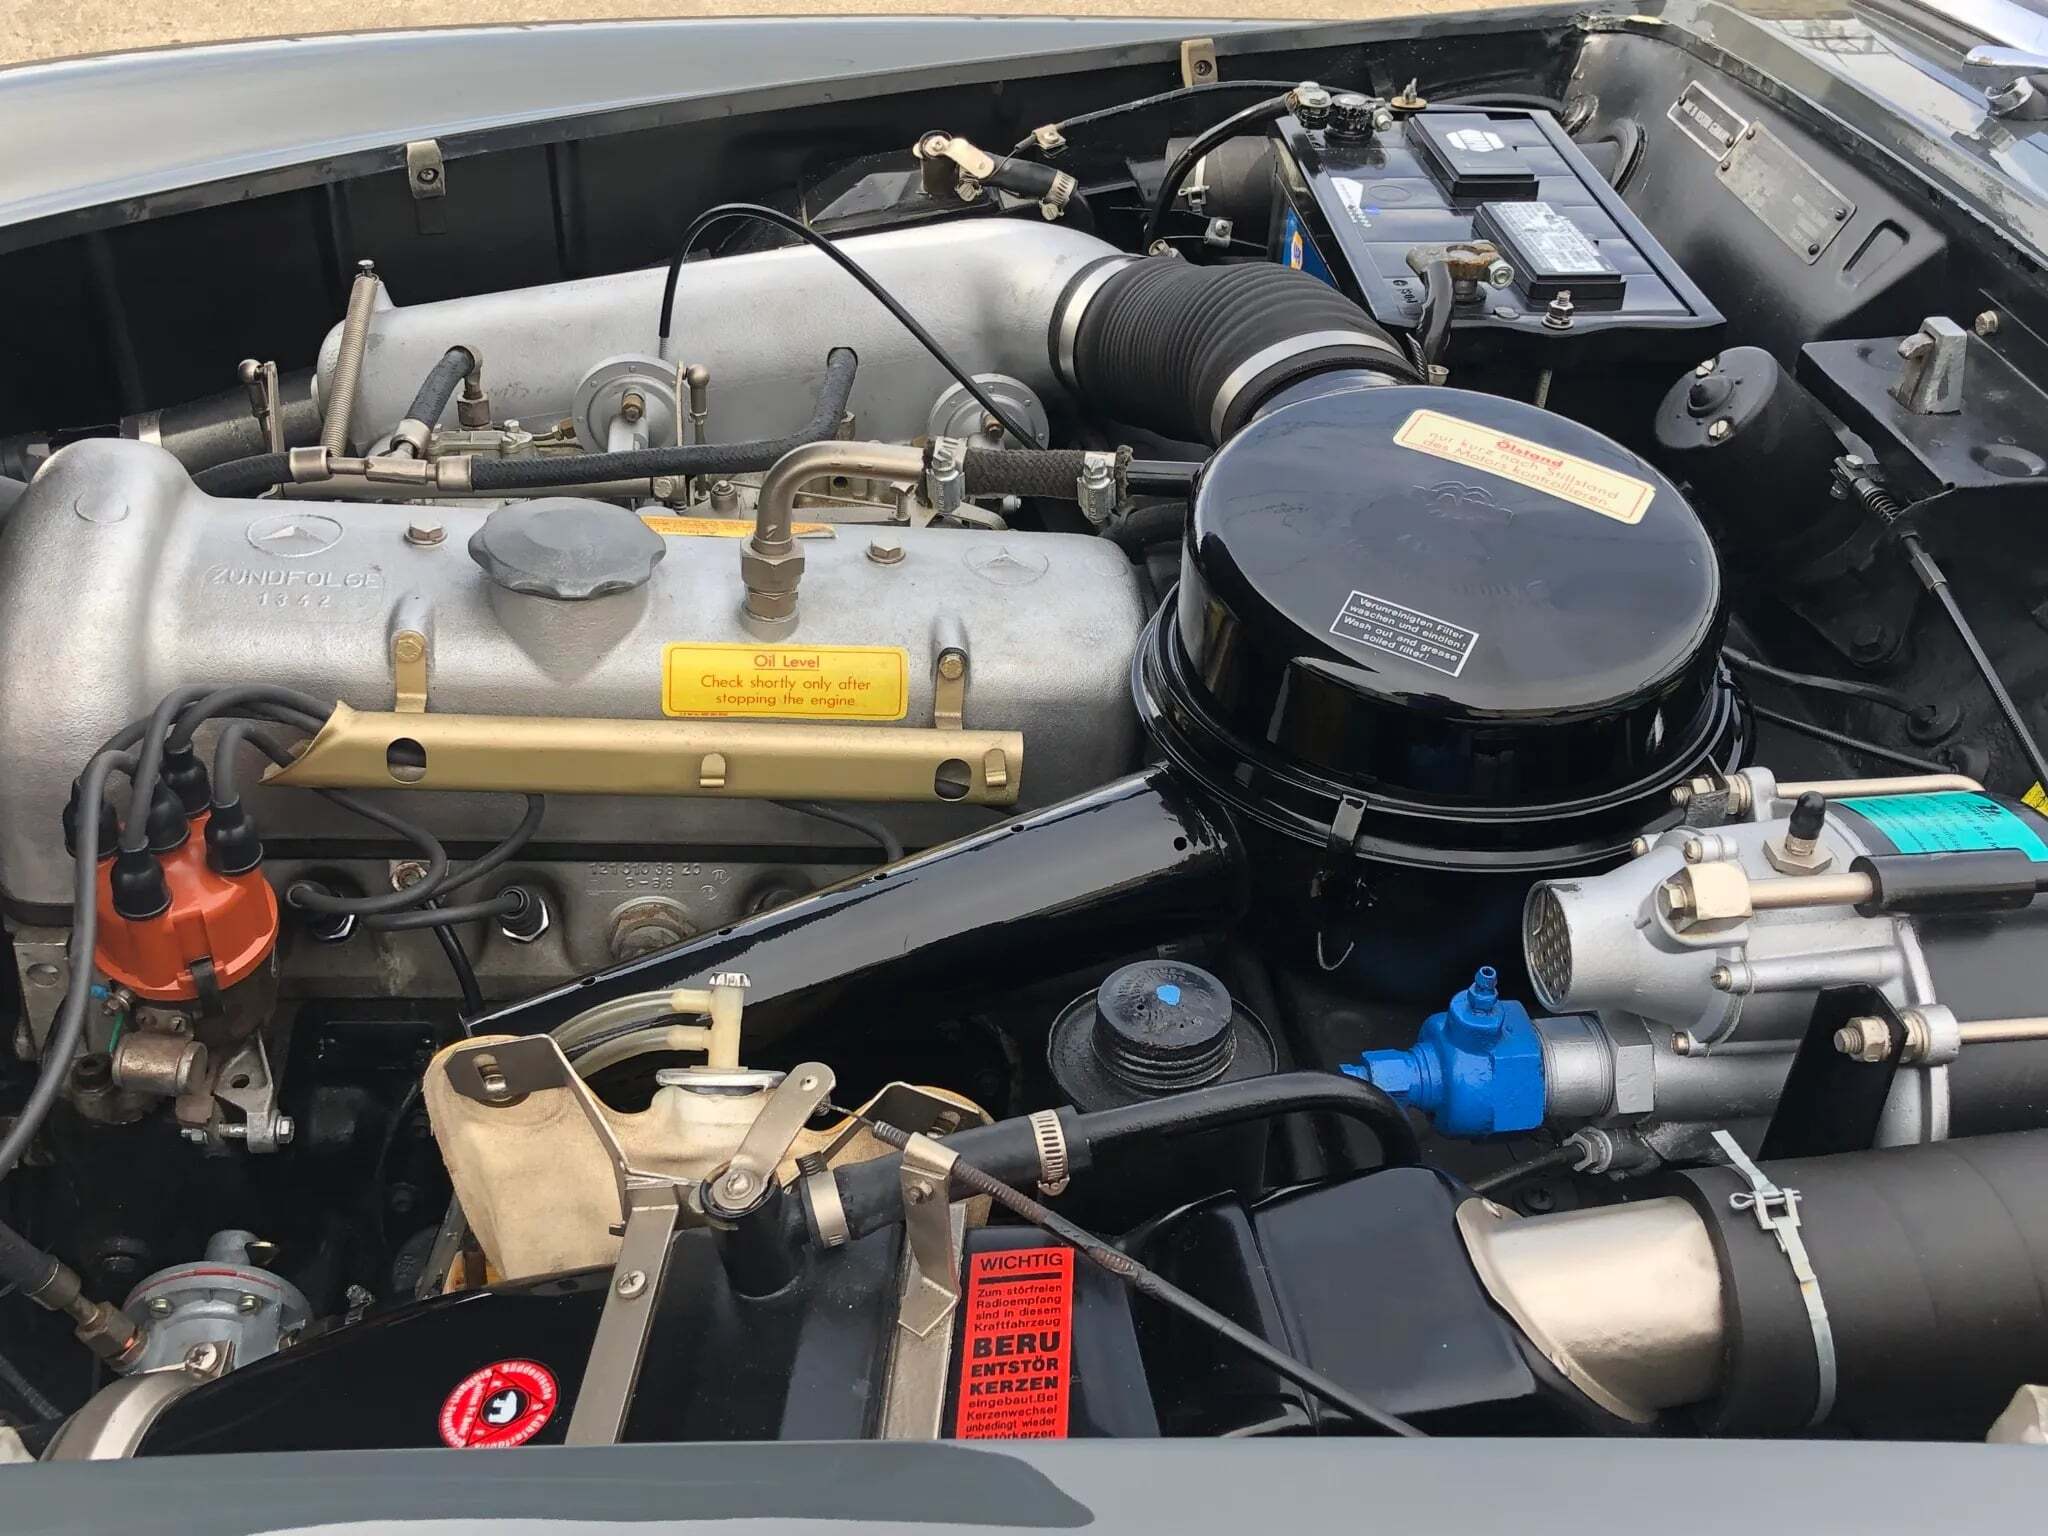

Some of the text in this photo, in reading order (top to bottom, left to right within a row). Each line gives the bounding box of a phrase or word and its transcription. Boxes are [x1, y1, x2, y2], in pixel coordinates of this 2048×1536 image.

[1422, 438, 1450, 452] des
[1455, 447, 1508, 471] Motors
[1496, 440, 1564, 468] Ölstand
[1429, 431, 1620, 500] nur kurz nach Stillstand
[1350, 605, 1466, 650] waschen und einölen!
[1360, 597, 1464, 640] Verunreinigten Filter
[1343, 616, 1458, 662] Wash out and grease
[1363, 633, 1430, 661] soiled filter!
[754, 654, 820, 668] Oil Level
[701, 675, 871, 694] Check shortly only after
[716, 691, 856, 709] stopping the engine
[980, 1252, 1063, 1271] WICHTIG
[978, 1284, 1062, 1298] Zum störfreien
[976, 1296, 1062, 1309] Radioempfang
[976, 1306, 1061, 1320] sind in diesem
[974, 1318, 1060, 1332] Kraftfahrzeug
[973, 1331, 1061, 1359] BERU
[971, 1355, 1059, 1378] ENTSTÖR
[969, 1376, 1059, 1396] KERZEN
[967, 1404, 1057, 1421] Kerzenwechsel
[966, 1417, 1056, 1432] unbedingt wieder
